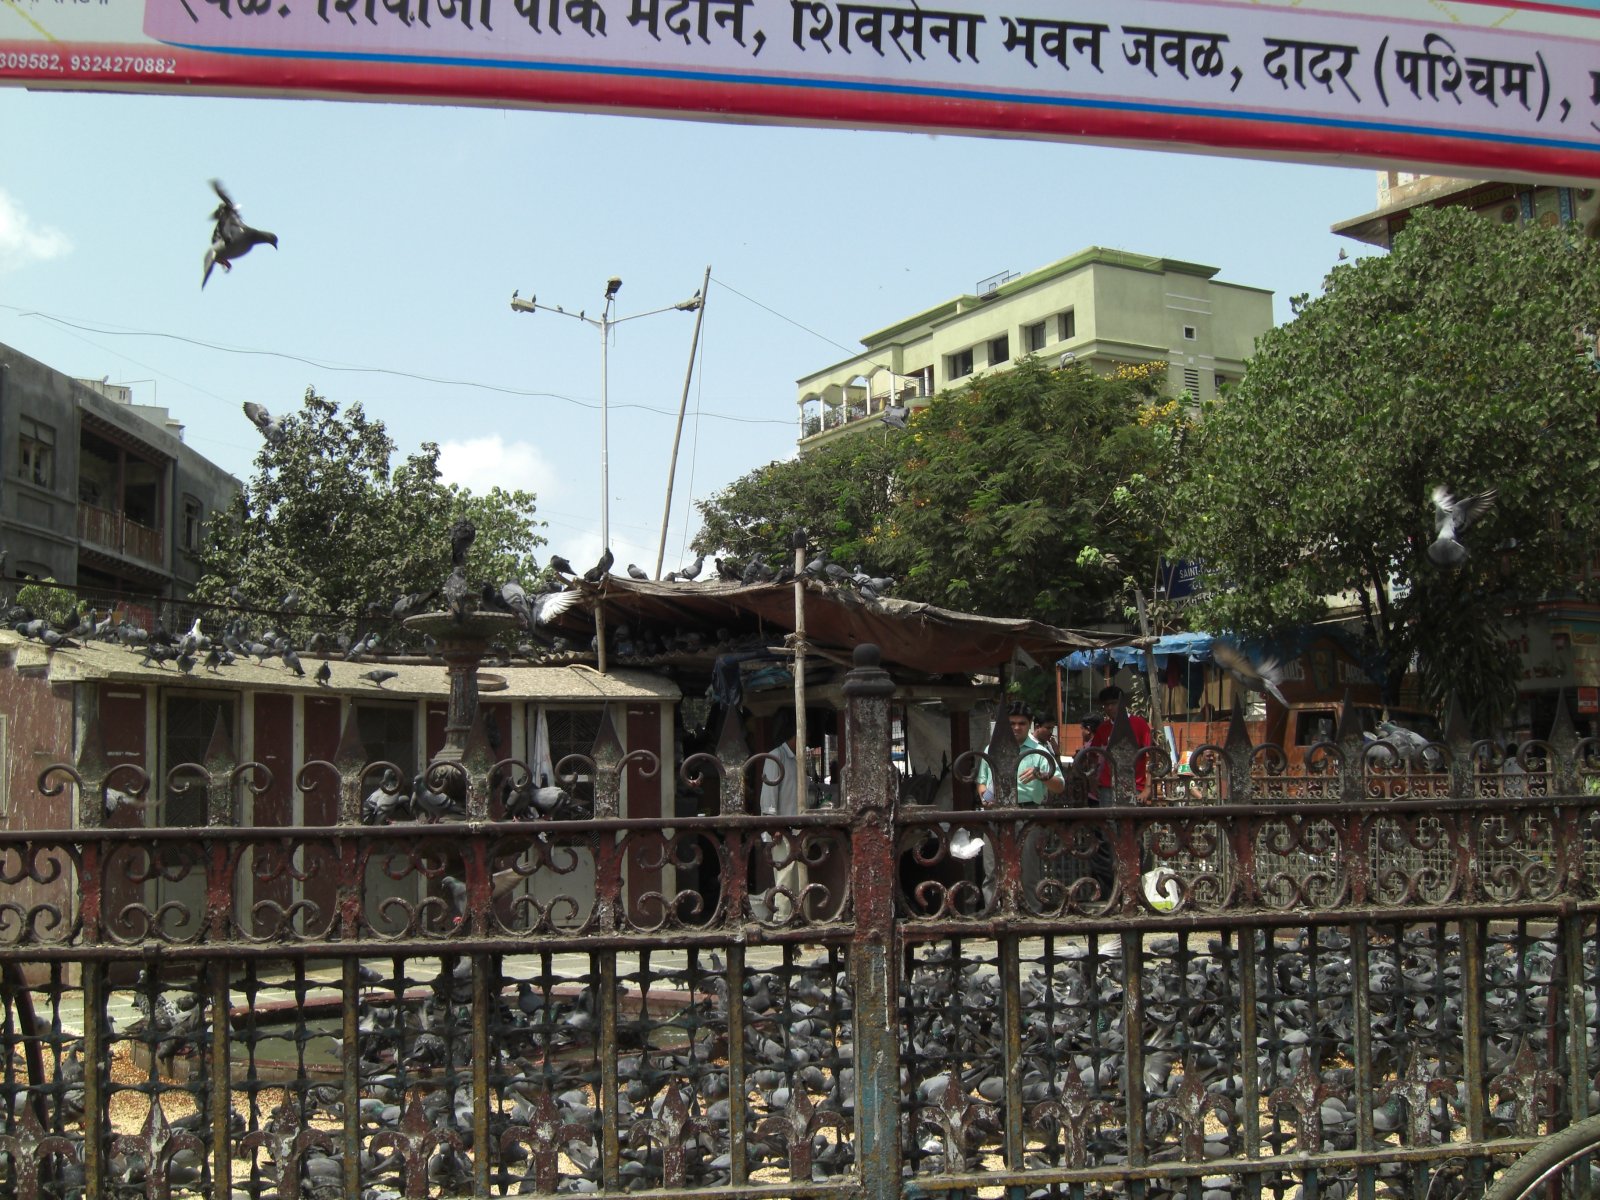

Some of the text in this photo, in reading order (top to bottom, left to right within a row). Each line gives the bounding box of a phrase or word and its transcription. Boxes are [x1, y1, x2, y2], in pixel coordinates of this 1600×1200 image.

[71, 56, 176, 74] 9324270882
[789, 0, 987, 64] शिवसेना
[1000, 16, 1110, 74] भवन
[1121, 25, 1243, 93] जवळ,
[1263, 37, 1361, 103] दादर
